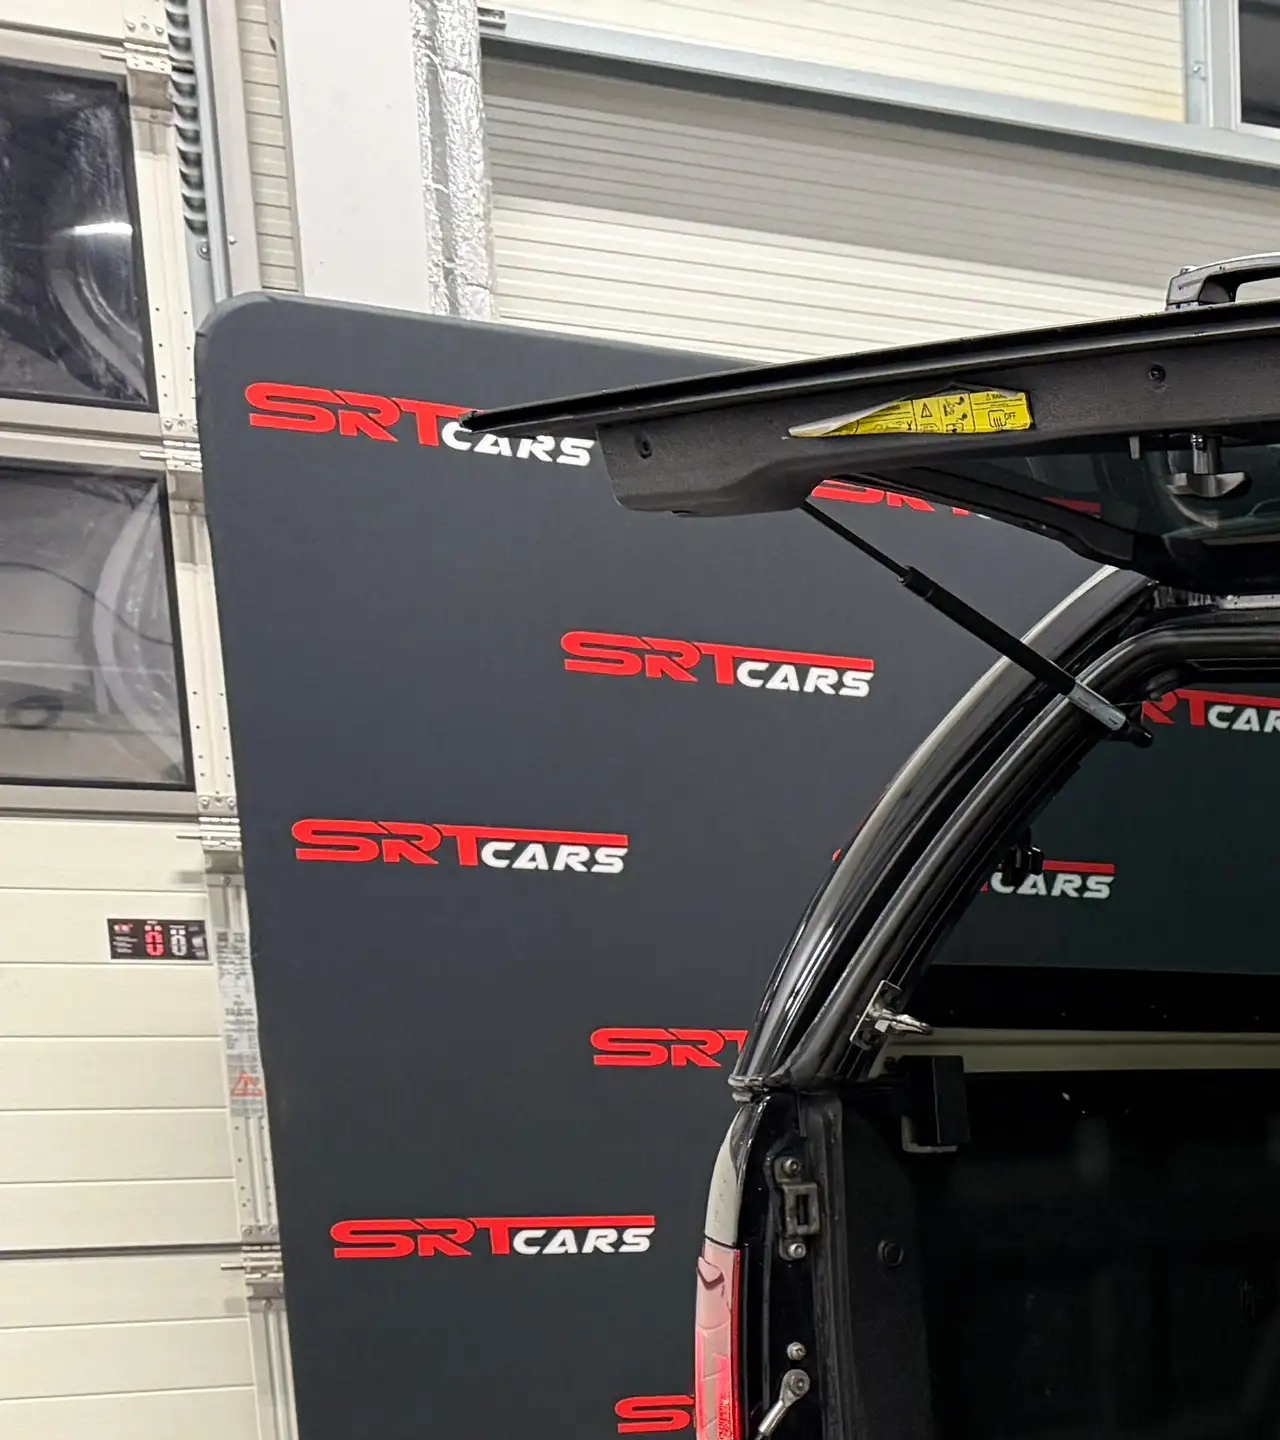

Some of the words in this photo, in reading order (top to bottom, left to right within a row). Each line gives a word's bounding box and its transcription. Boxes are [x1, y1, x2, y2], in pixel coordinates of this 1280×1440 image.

[737, 661, 875, 698] CARS
[481, 841, 629, 874] CARS
[513, 1227, 656, 1255] CARS
